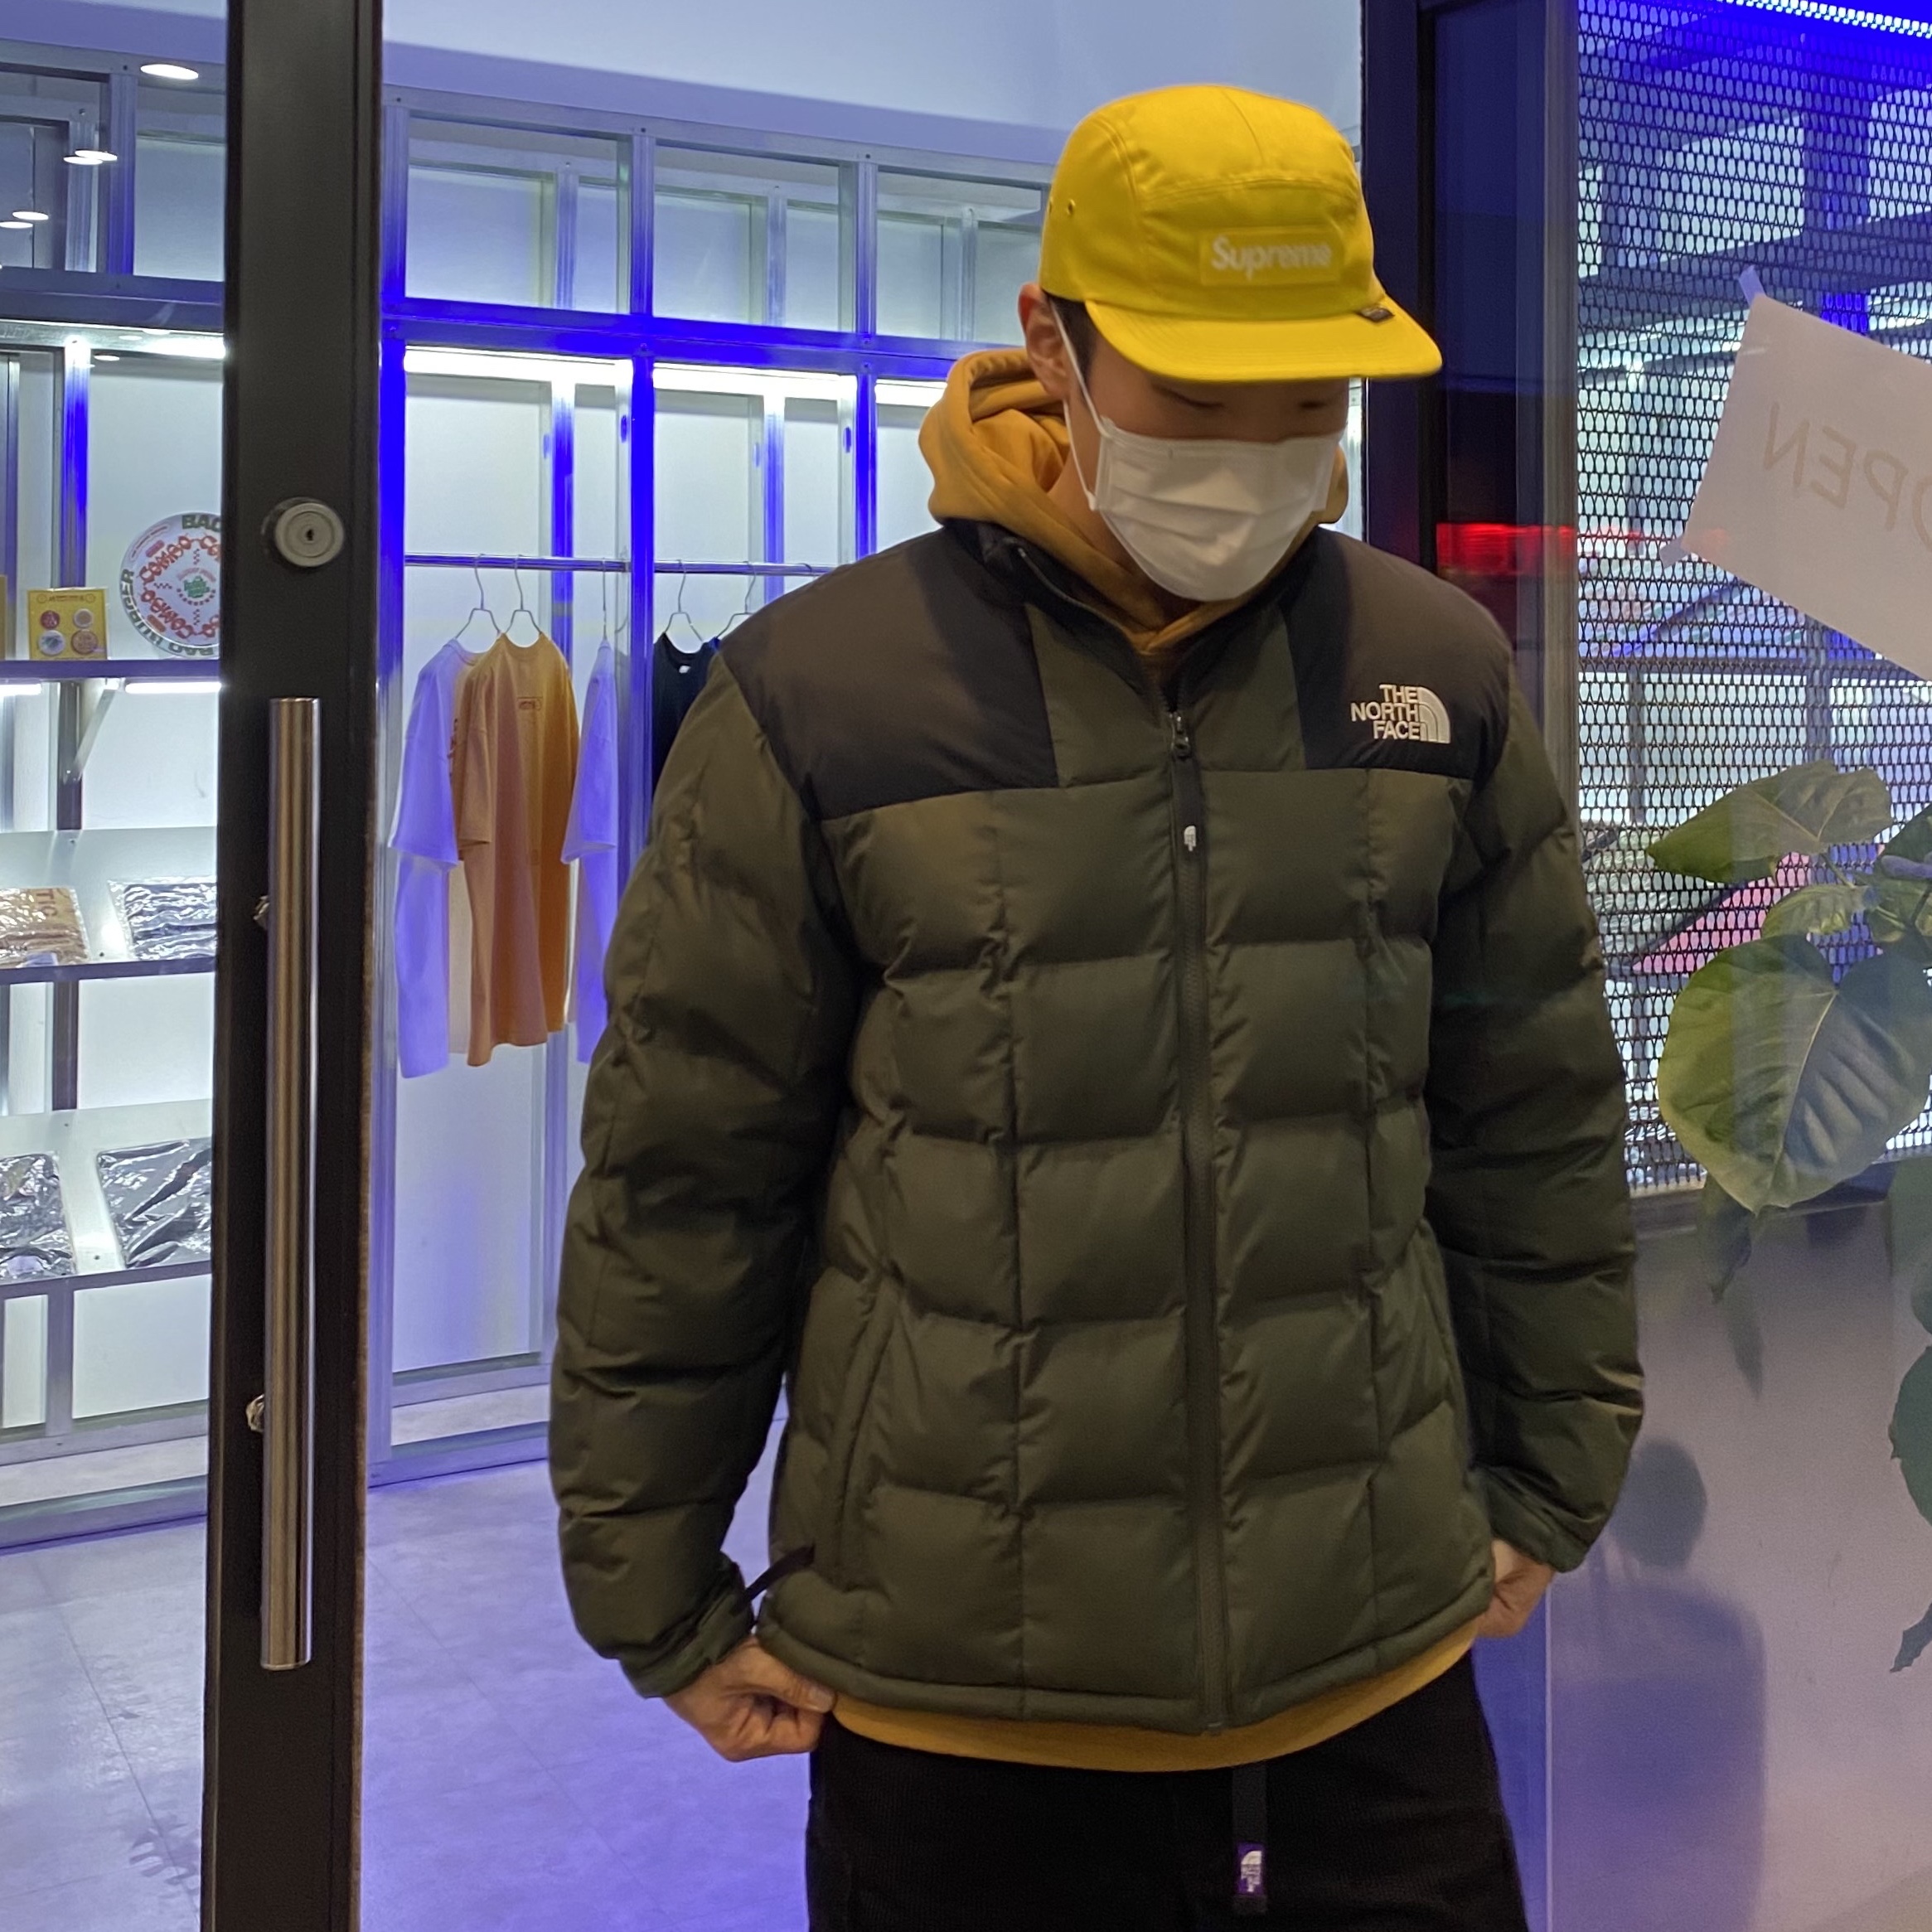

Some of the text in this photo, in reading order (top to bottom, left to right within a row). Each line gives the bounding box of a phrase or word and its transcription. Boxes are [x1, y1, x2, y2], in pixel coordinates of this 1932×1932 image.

[1211, 235, 1332, 282] Supreme
[141, 589, 194, 639] COMBO
[1379, 684, 1418, 704] THE
[1350, 701, 1419, 722] NORTH
[1373, 720, 1421, 740] FACE
